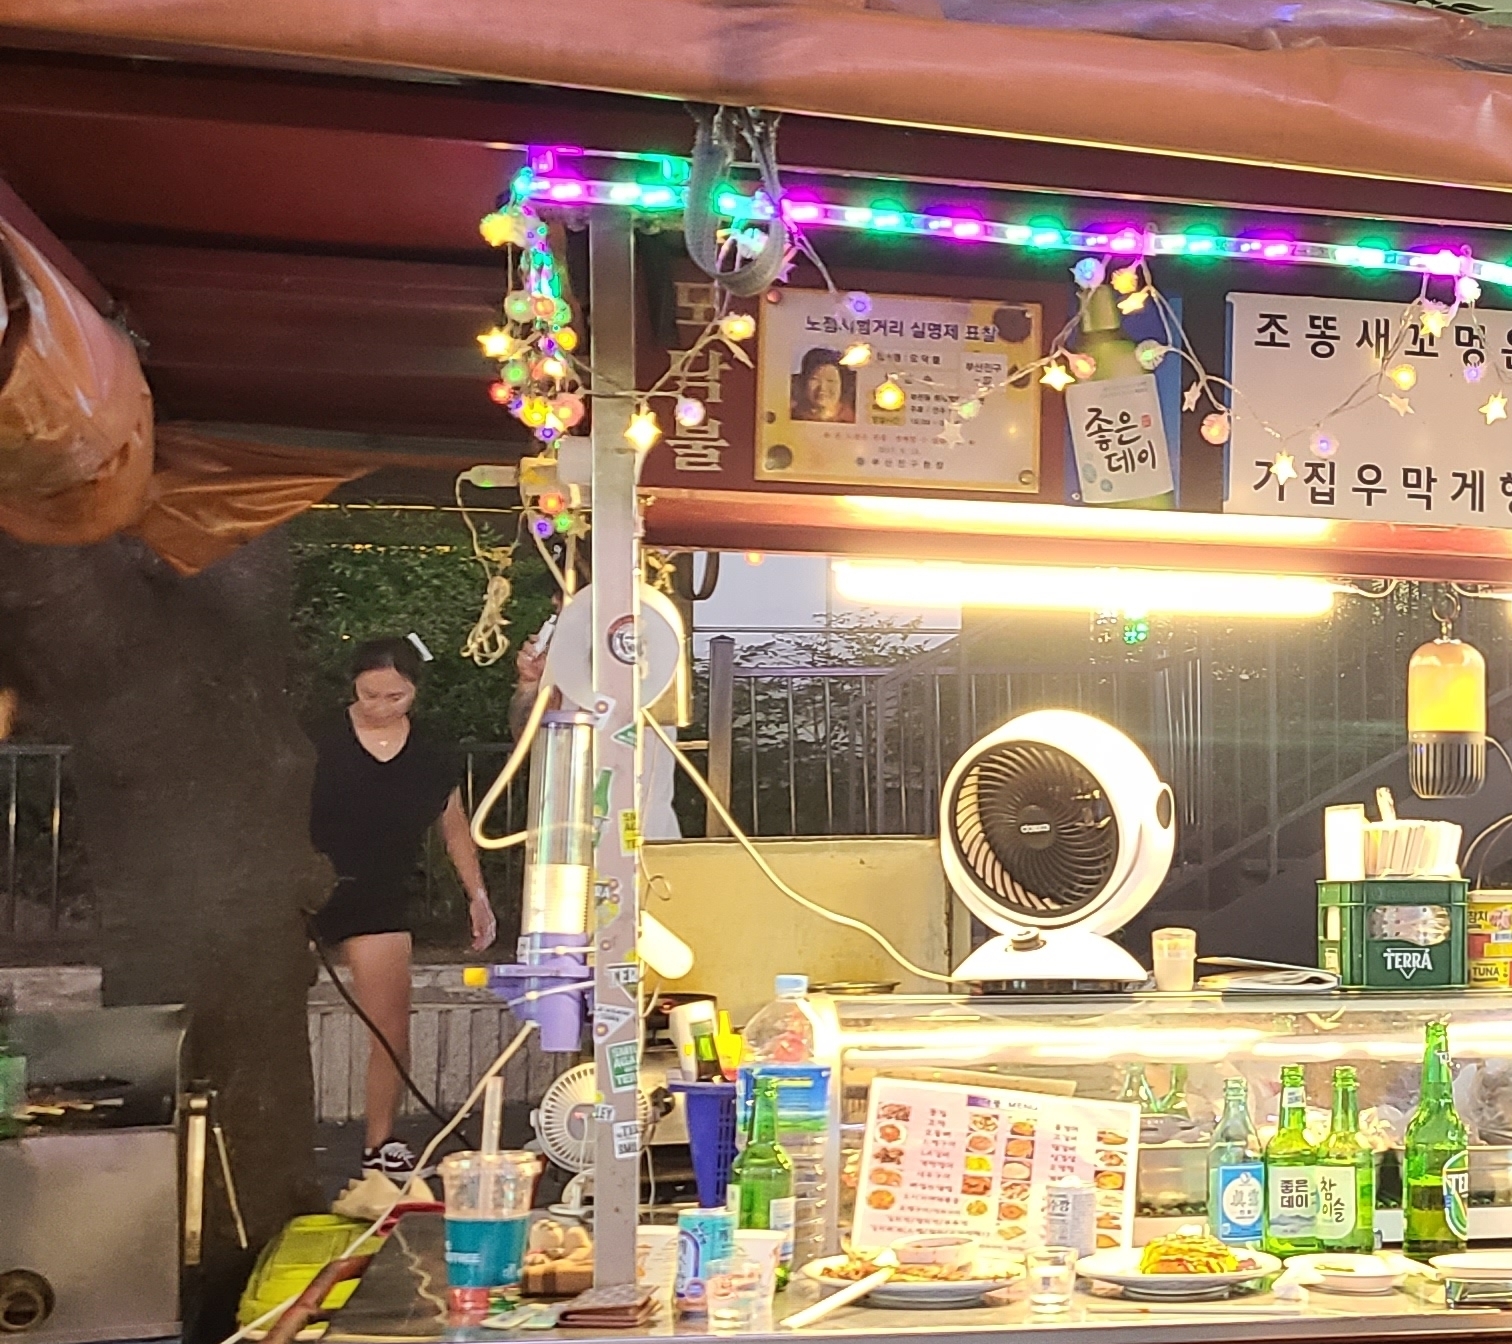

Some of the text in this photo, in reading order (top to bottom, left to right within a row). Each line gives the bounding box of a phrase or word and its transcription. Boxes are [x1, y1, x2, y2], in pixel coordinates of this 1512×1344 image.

[910, 320, 959, 341] 실명제
[965, 325, 998, 343] 표찰
[1085, 407, 1142, 452] 좋은
[1104, 440, 1156, 474] 데이
[1383, 948, 1433, 972] TERRA
[1472, 966, 1500, 977] TUNA
[1280, 1179, 1308, 1194] 좋은
[1280, 1194, 1309, 1208] 데이
